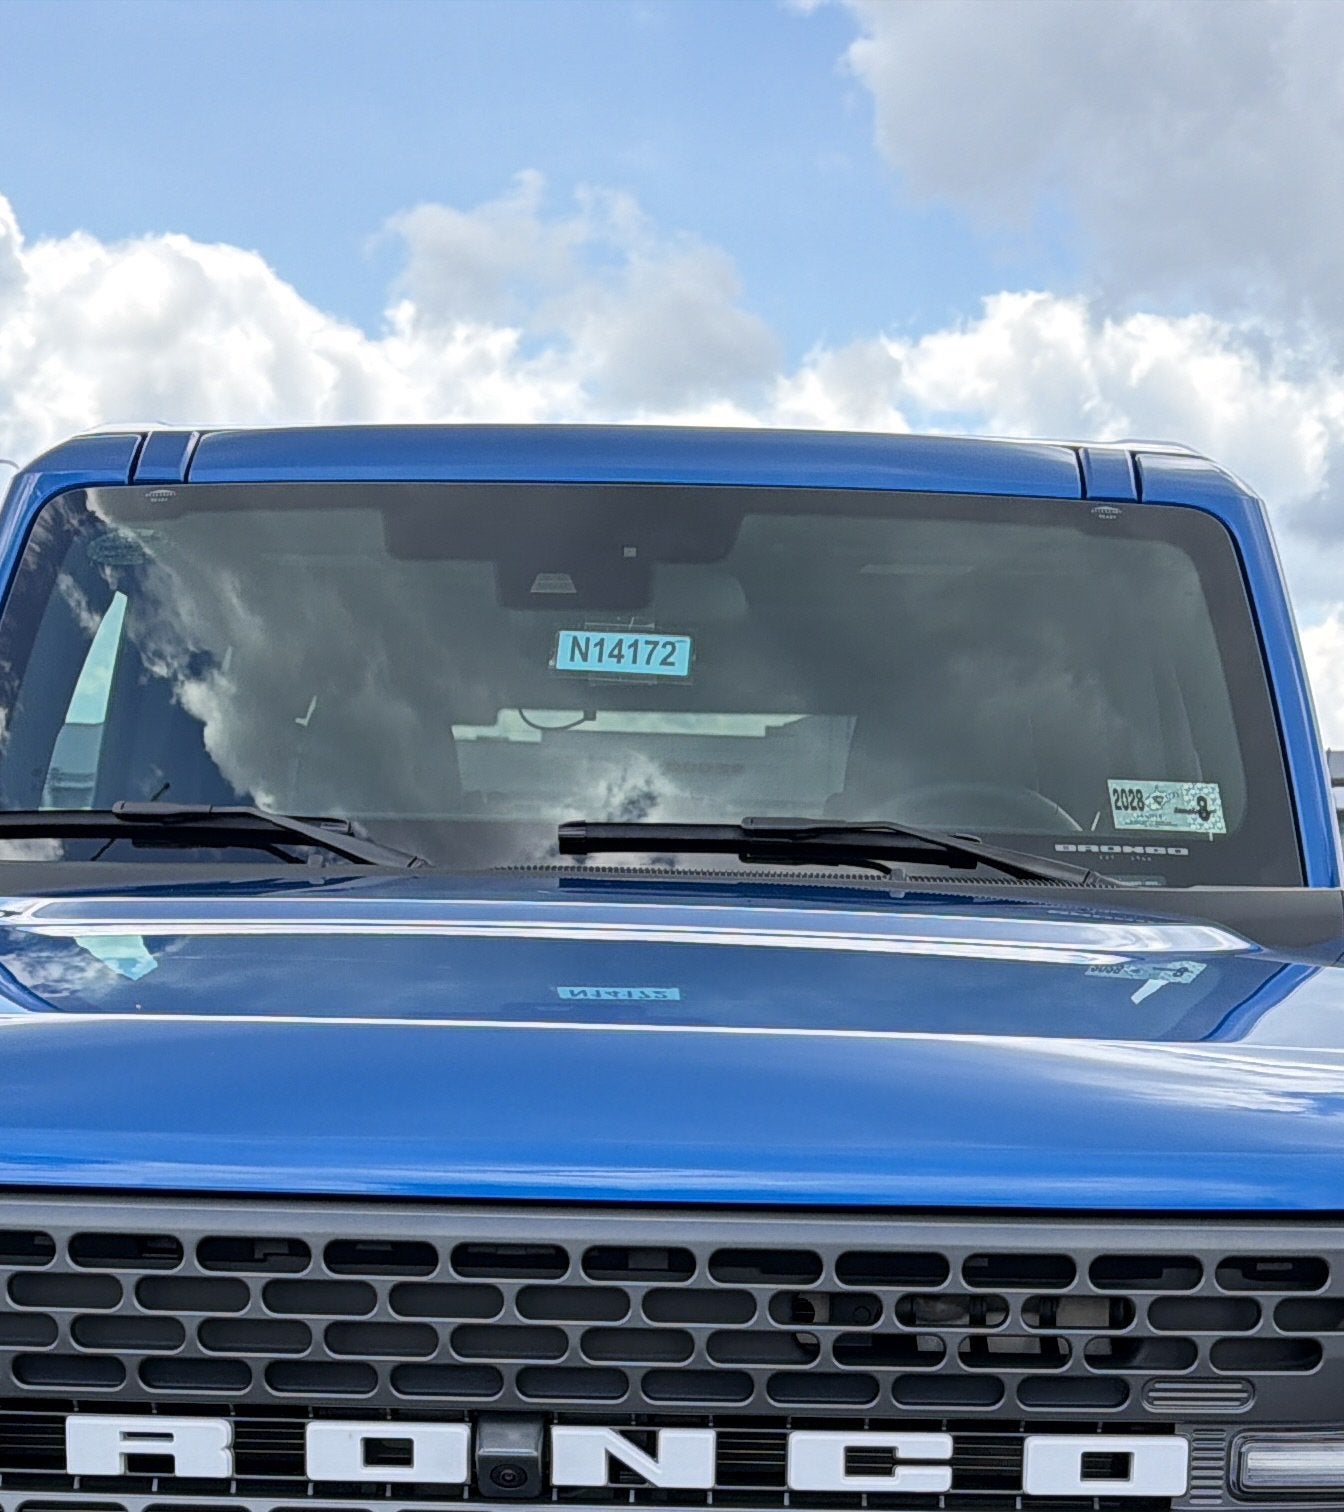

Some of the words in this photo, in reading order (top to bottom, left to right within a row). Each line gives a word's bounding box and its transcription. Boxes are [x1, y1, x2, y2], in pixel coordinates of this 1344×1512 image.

[569, 635, 677, 667] N14172
[1112, 787, 1145, 812] 2028
[1054, 843, 1189, 856] BRONCO
